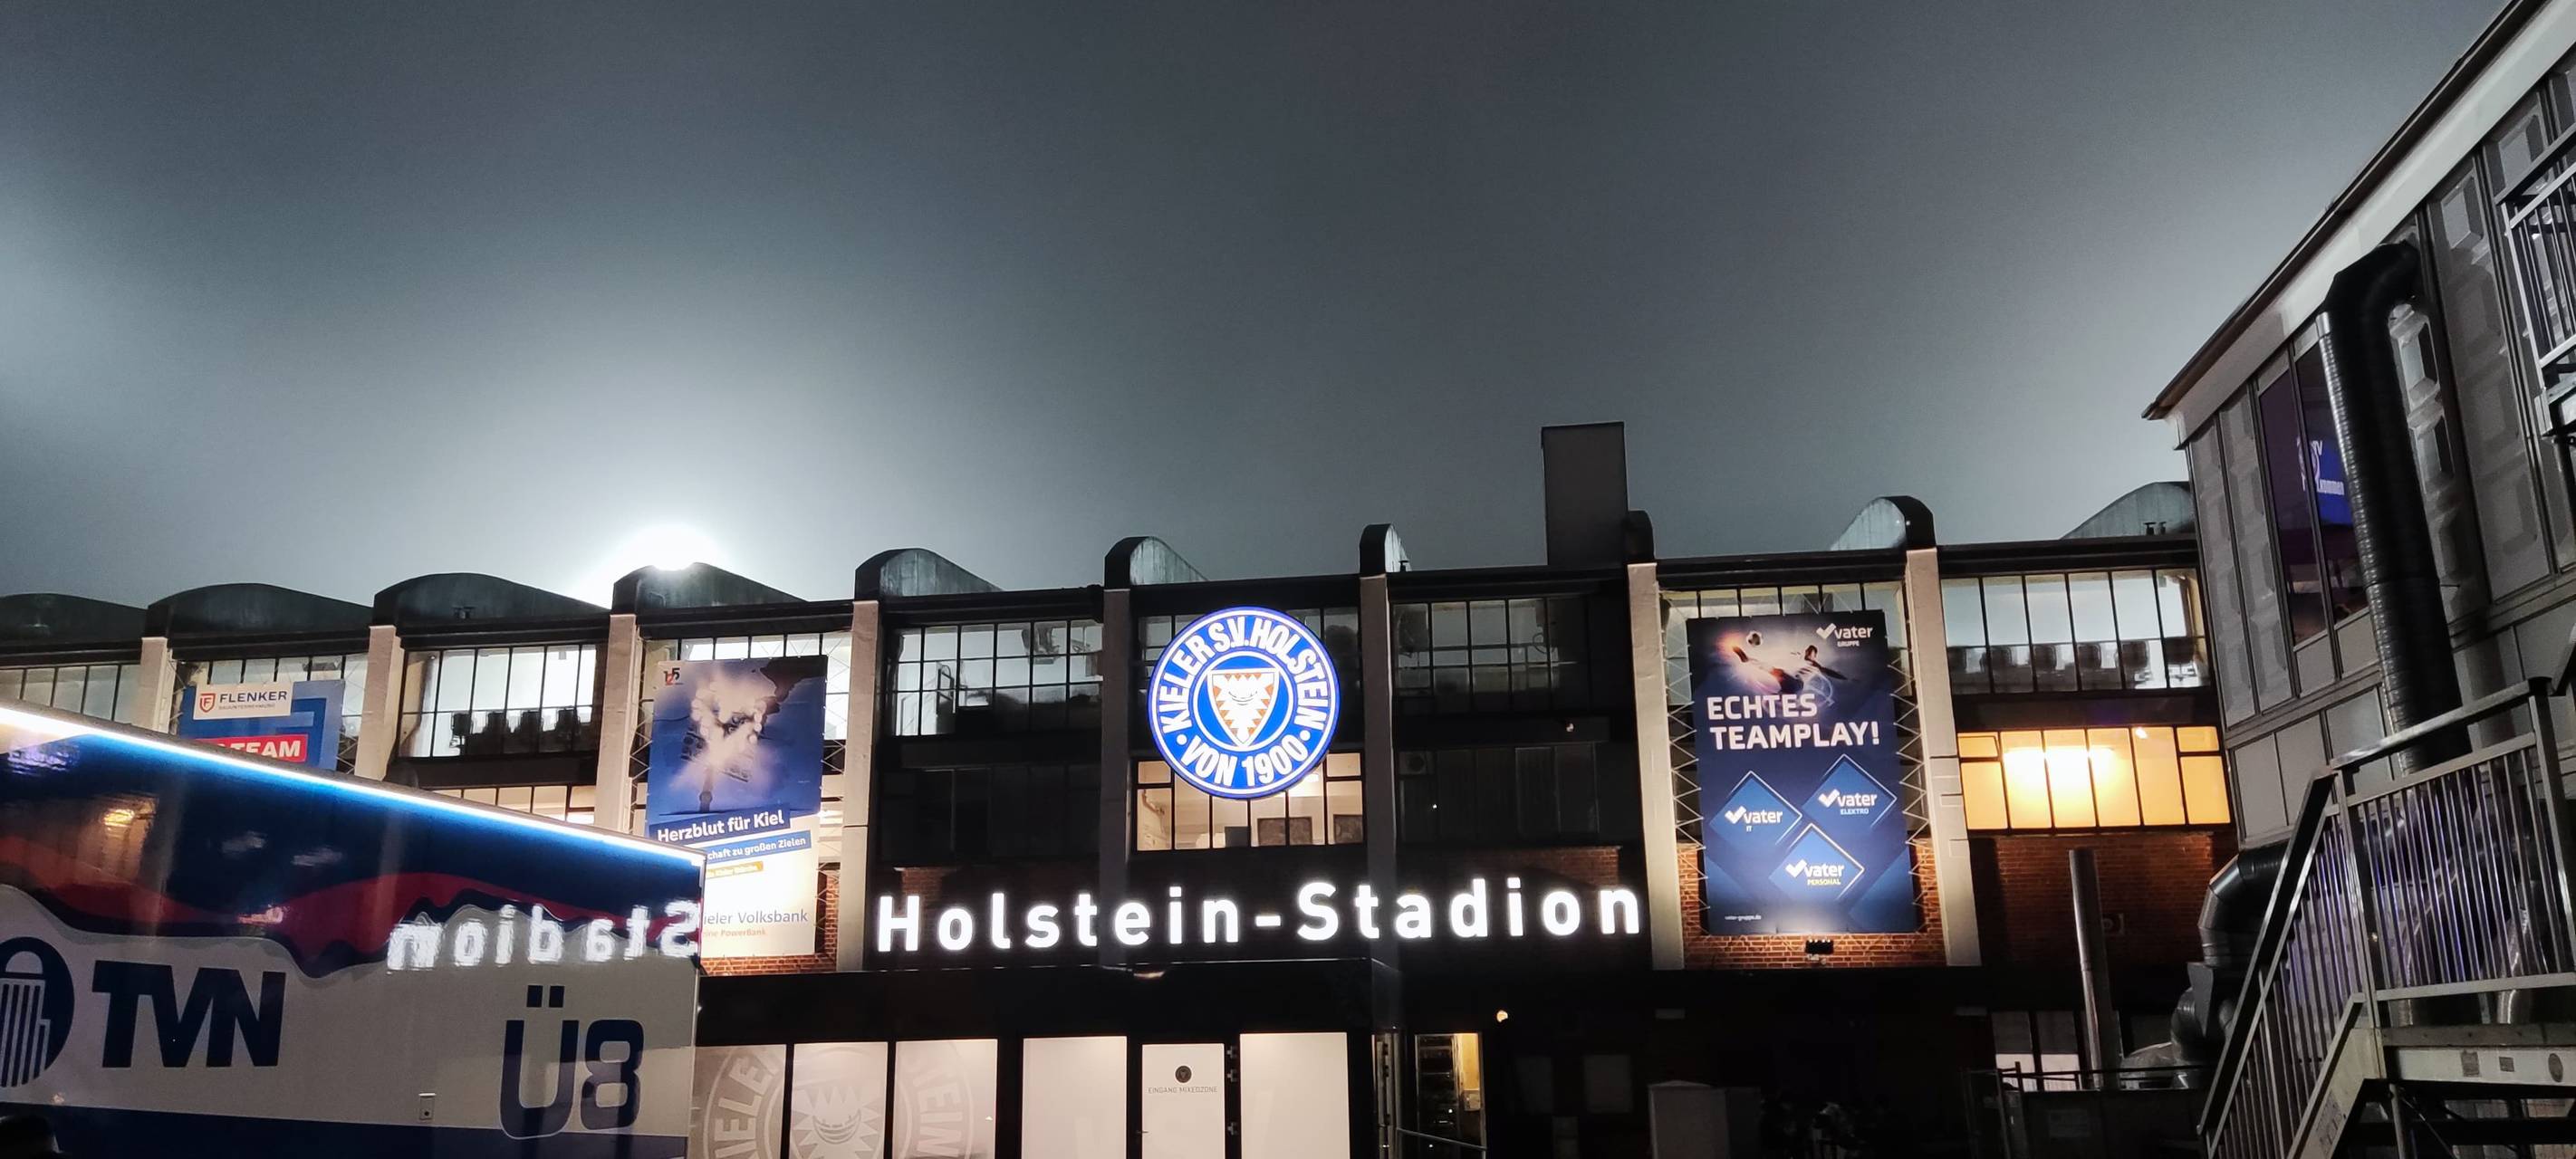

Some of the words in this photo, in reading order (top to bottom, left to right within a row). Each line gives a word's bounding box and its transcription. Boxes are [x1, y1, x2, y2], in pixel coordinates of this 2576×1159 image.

[1834, 626, 1873, 639] vater
[1158, 634, 1216, 734] KIELER
[1249, 617, 1331, 732] HOLSTEIN
[219, 690, 287, 704] FLENKER
[1706, 693, 1818, 721] ECHTES
[1709, 721, 1880, 751] TEAMPLAY!
[1179, 734, 1238, 787] VON
[1241, 733, 1310, 787] 1900
[1837, 792, 1878, 807] vater
[657, 819, 726, 843] Herzblut
[727, 815, 751, 832] für
[754, 809, 785, 829] Kiel
[1744, 809, 1783, 824] vater
[732, 848, 744, 857] zu
[745, 842, 777, 857] großen
[778, 838, 806, 849] Zielen
[1804, 863, 1845, 877] vater
[1807, 878, 1841, 886] PERSONAL
[738, 908, 808, 924] Volksbank
[876, 876, 1641, 953] Holstein-Stadion
[91, 960, 286, 1068] TVN
[500, 984, 645, 1140] Ü8
